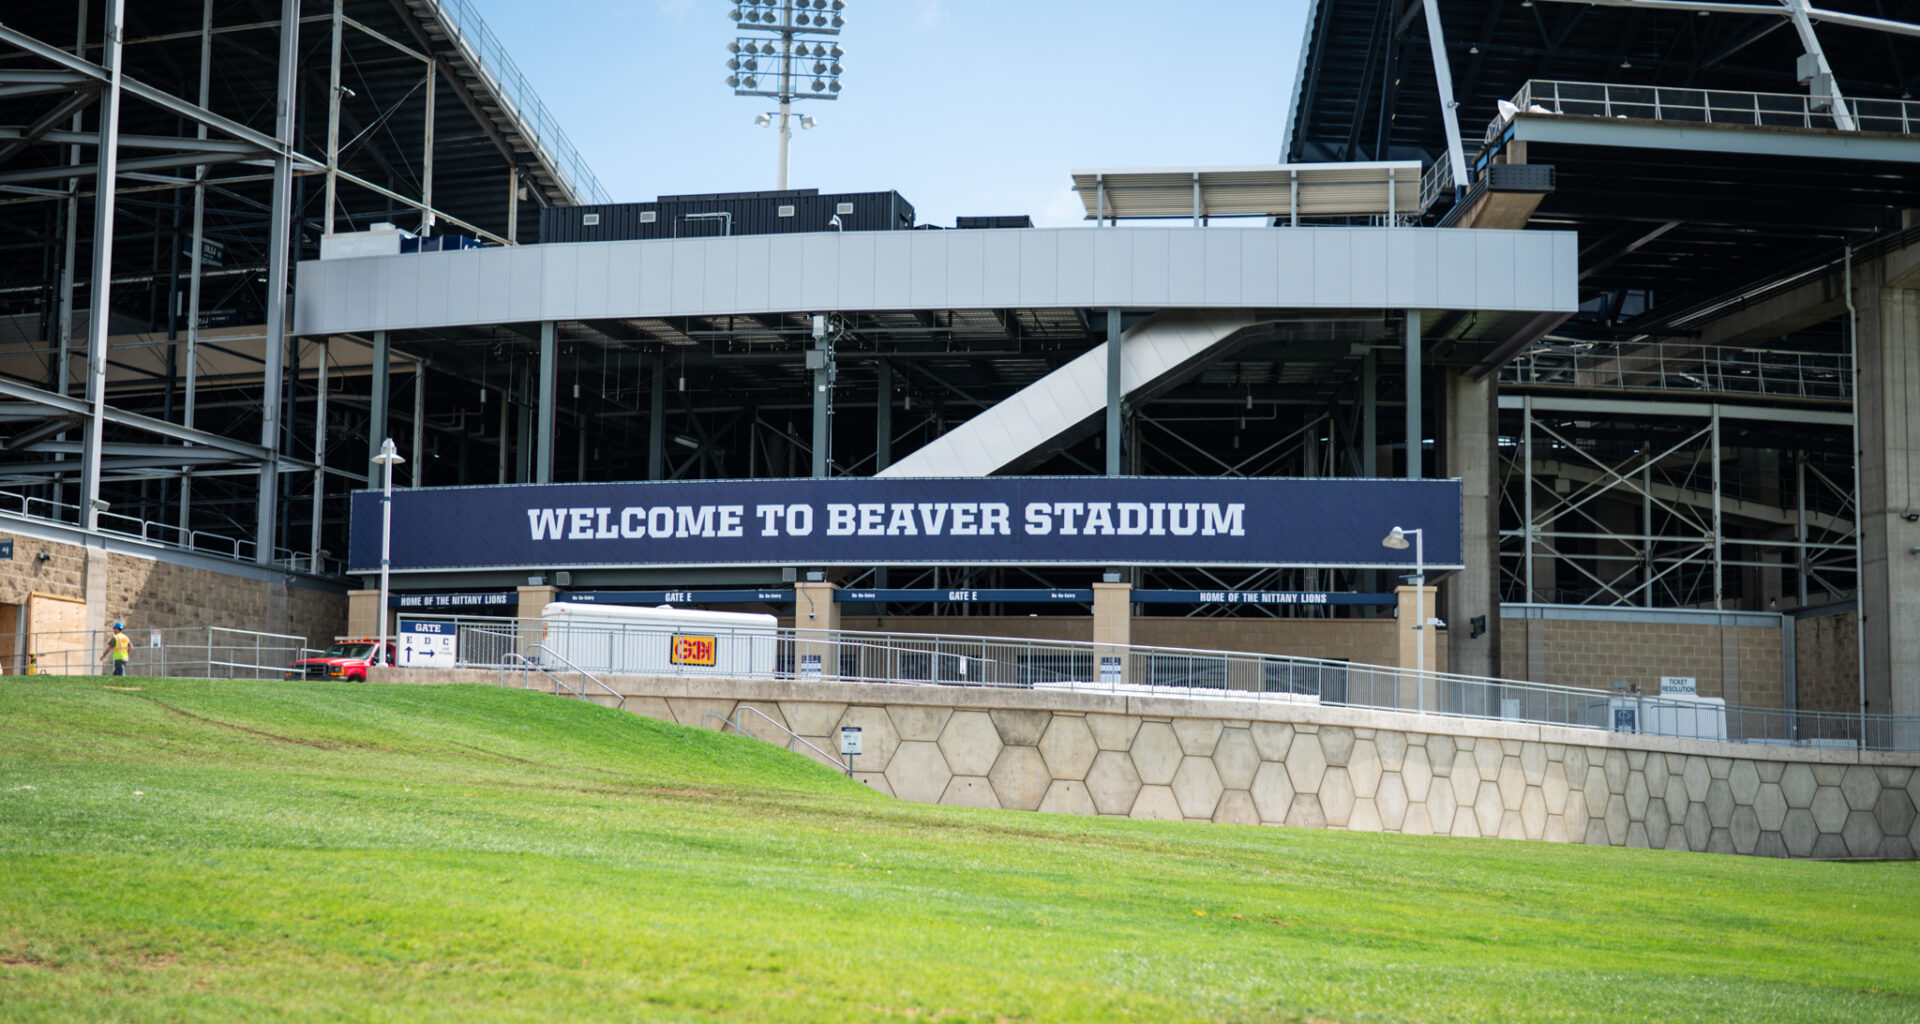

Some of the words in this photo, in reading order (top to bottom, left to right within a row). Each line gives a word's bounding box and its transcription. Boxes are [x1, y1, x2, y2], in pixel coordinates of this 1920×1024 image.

[527, 505, 744, 540] WELCOME
[756, 504, 813, 537] TO
[826, 503, 1011, 536] BEAVER
[1024, 502, 1246, 536] STADIUM
[401, 596, 422, 606] HOME
[424, 596, 434, 606] OF
[436, 596, 450, 606] THE
[452, 595, 482, 605] NITTANY
[484, 595, 507, 604] LIONS
[665, 592, 684, 602] GATE
[687, 592, 692, 602] E
[949, 591, 969, 601] GATE
[972, 591, 978, 601] E
[1200, 592, 1225, 602] HOME
[1227, 592, 1239, 602] OF
[1242, 592, 1259, 603] THE
[1261, 593, 1298, 603] NITTANY
[1301, 593, 1327, 604] LIONS
[415, 623, 442, 633] GATE
[406, 636, 413, 644] E
[424, 637, 431, 645] D
[442, 637, 449, 646] C
